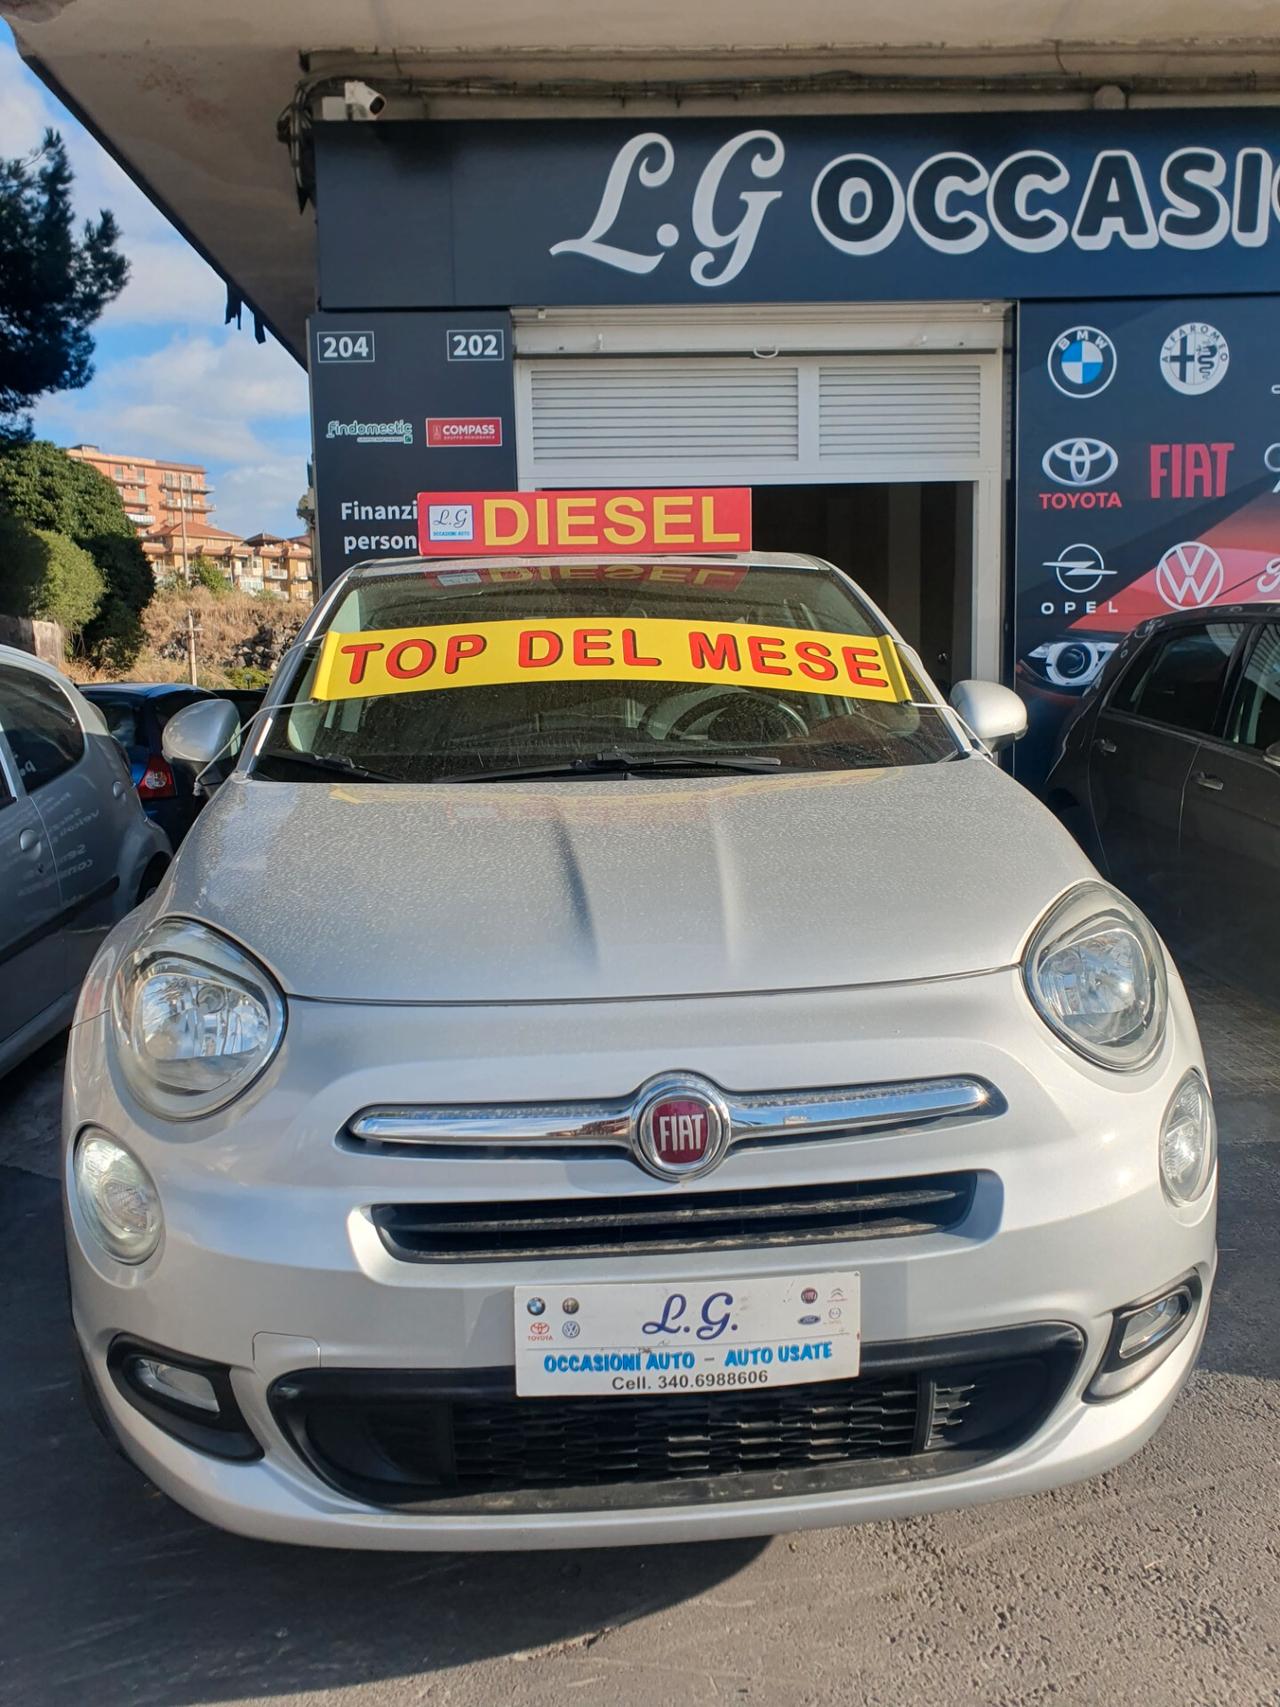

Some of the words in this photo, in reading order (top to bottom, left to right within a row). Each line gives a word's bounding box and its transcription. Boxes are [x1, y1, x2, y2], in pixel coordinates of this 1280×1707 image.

[549, 130, 785, 287] L.G
[810, 146, 1280, 256] OCCASI
[323, 336, 370, 358] 204
[452, 334, 498, 357] 202
[442, 424, 496, 436] COMPASS
[1150, 443, 1235, 498] FIAT
[1039, 491, 1122, 510] TOYOTA
[484, 495, 741, 547] DIESEL
[1040, 602, 1118, 615] OPEL
[341, 633, 487, 685] TOP
[517, 628, 662, 668] DEL
[689, 631, 889, 688] MESE
[659, 1114, 704, 1152] FIAT
[642, 1291, 738, 1341] L.G.
[543, 1353, 641, 1374] OCCASIONI
[646, 1350, 695, 1372] AUTO
[724, 1347, 774, 1368] AUTO
[778, 1341, 833, 1362] USATE
[612, 1376, 652, 1391] Cell.
[657, 1370, 769, 1390] 340.6988606
